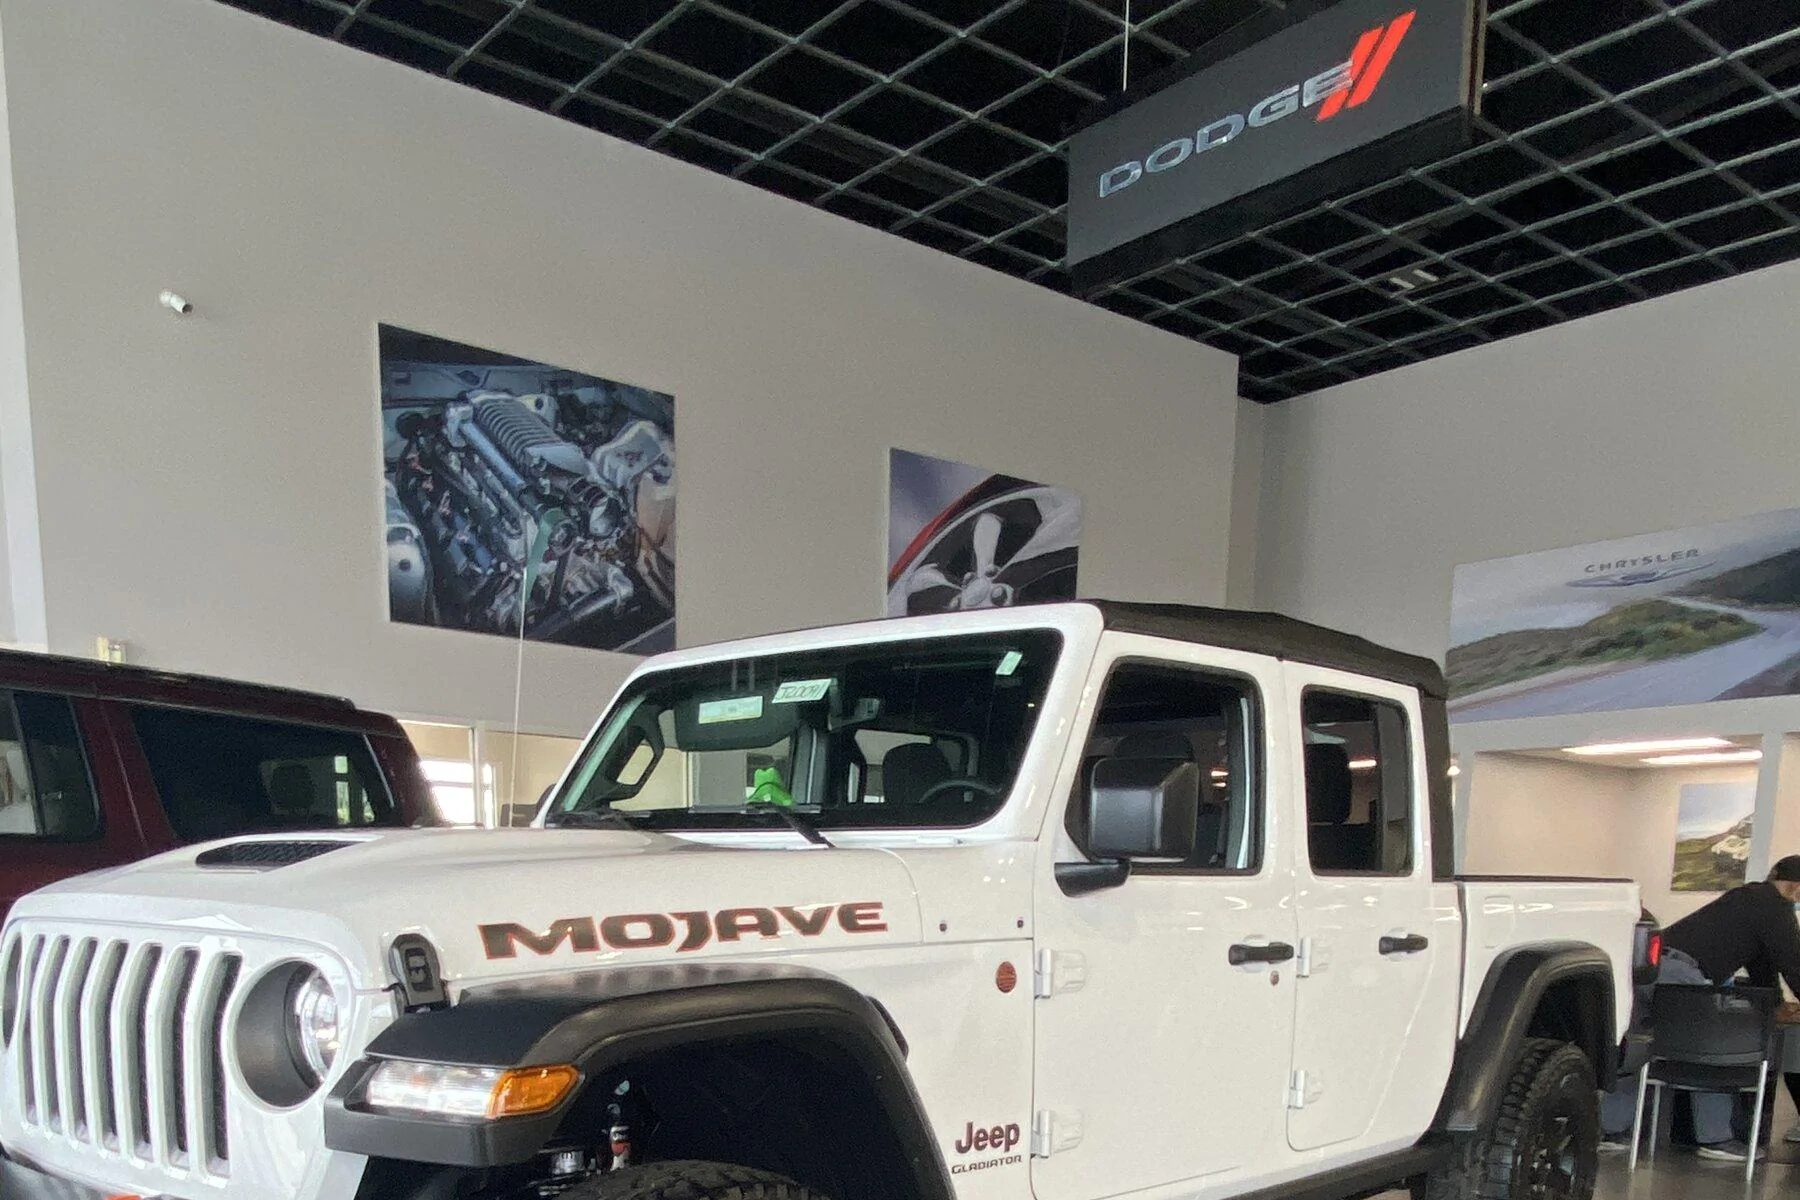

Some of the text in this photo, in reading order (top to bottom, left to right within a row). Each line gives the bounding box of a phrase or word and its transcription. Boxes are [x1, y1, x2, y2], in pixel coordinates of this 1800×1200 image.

[1100, 60, 1353, 198] DODGE
[1584, 549, 1699, 573] CHRYSLER
[478, 902, 888, 960] MOJAVE
[955, 1122, 1020, 1154] Jeep
[951, 1155, 1022, 1174] GLADIATOR
